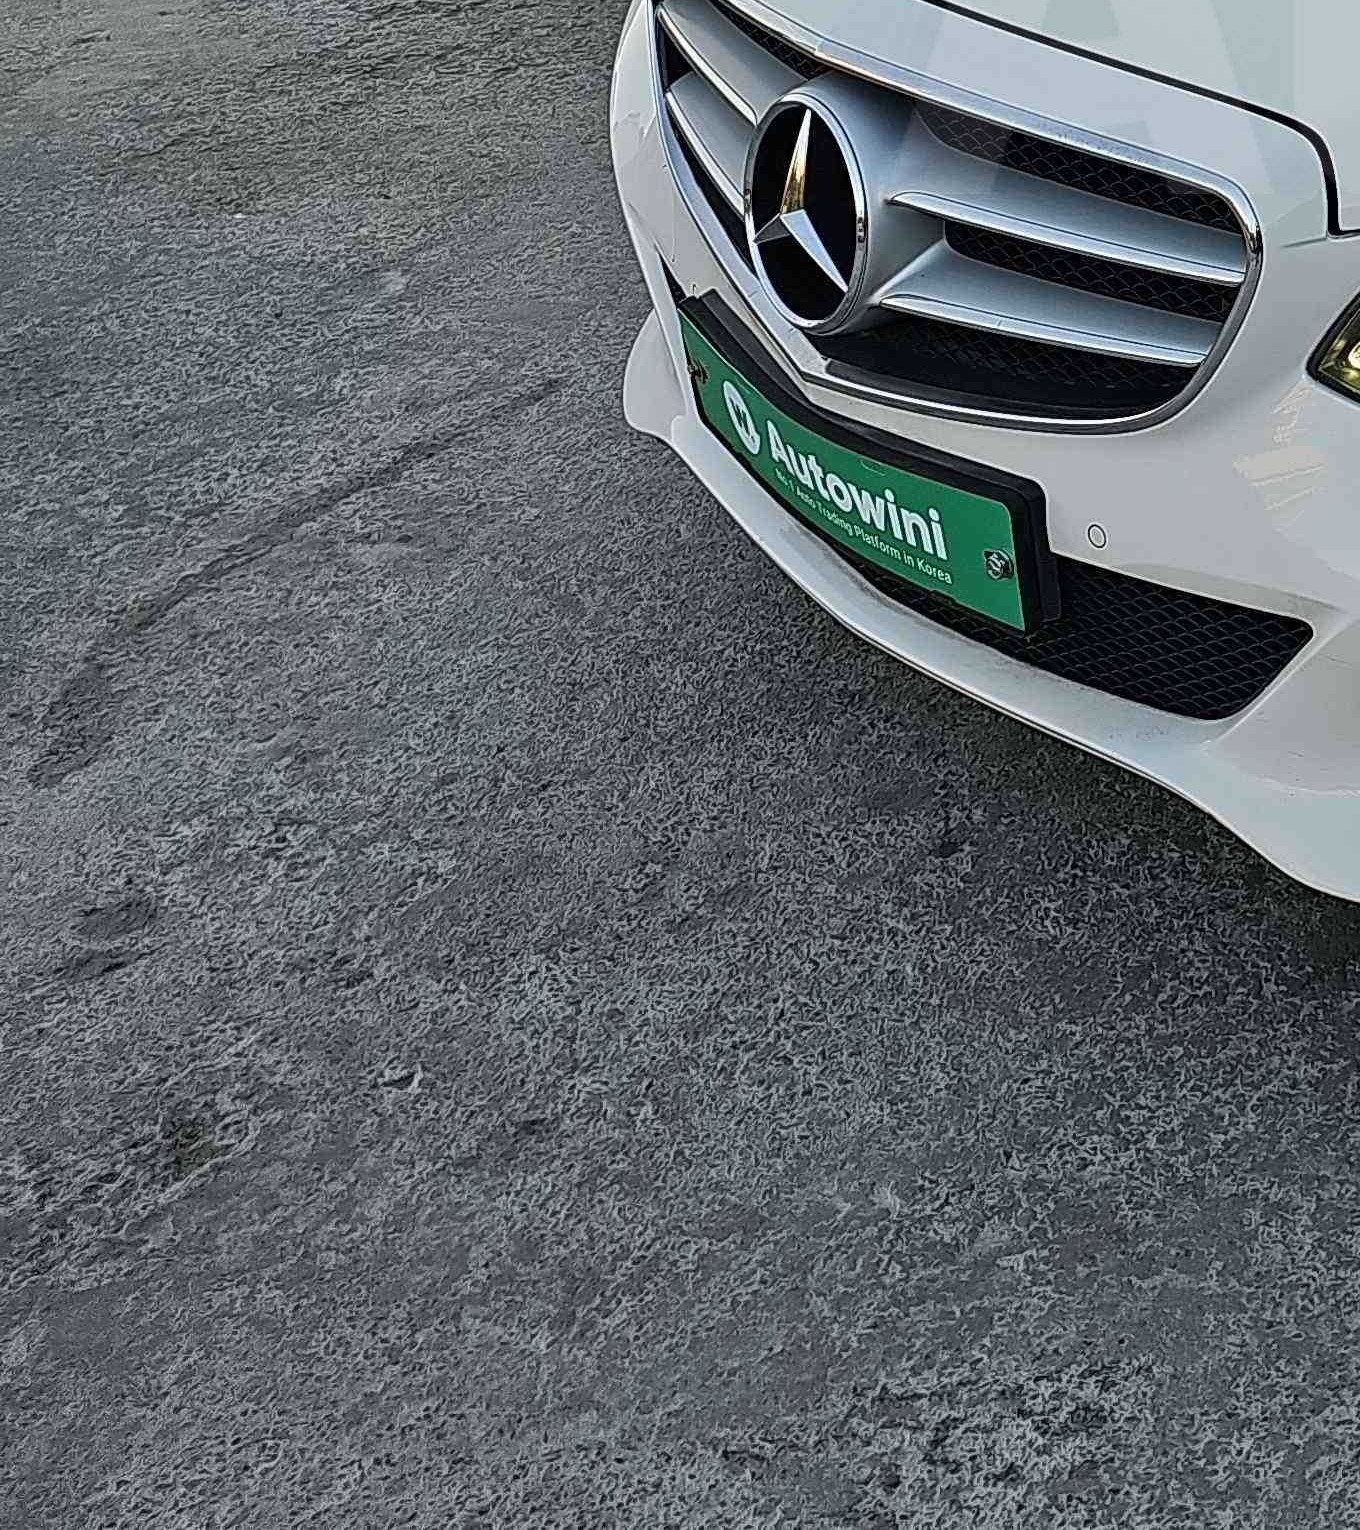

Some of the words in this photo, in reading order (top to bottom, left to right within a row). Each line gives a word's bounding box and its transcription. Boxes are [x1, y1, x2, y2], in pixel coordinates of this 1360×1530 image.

[766, 420, 948, 560] Autowini
[854, 524, 901, 559] Platform
[902, 550, 915, 569] in
[916, 556, 953, 584] Korea
